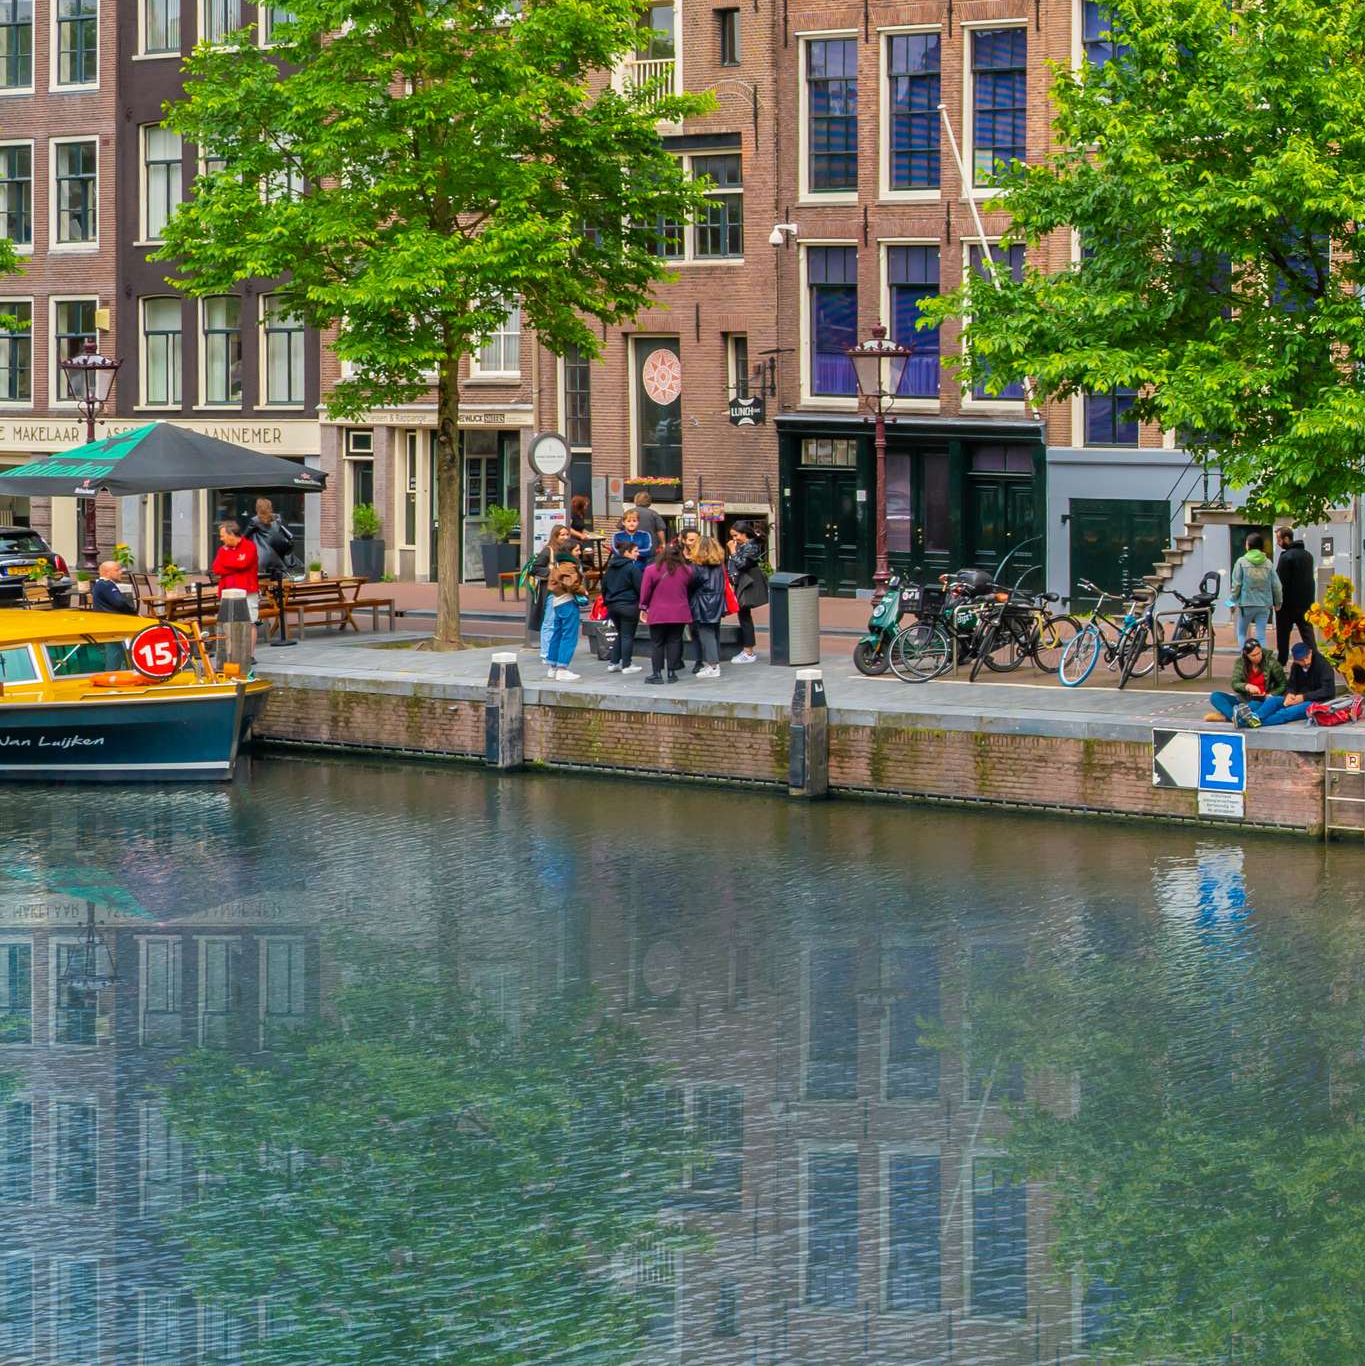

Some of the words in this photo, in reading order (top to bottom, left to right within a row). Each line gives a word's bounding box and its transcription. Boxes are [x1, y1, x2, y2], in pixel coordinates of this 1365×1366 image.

[731, 406, 754, 417] LUNCH
[13, 426, 80, 442] MAKELAAR
[38, 735, 104, 749] Luijken
